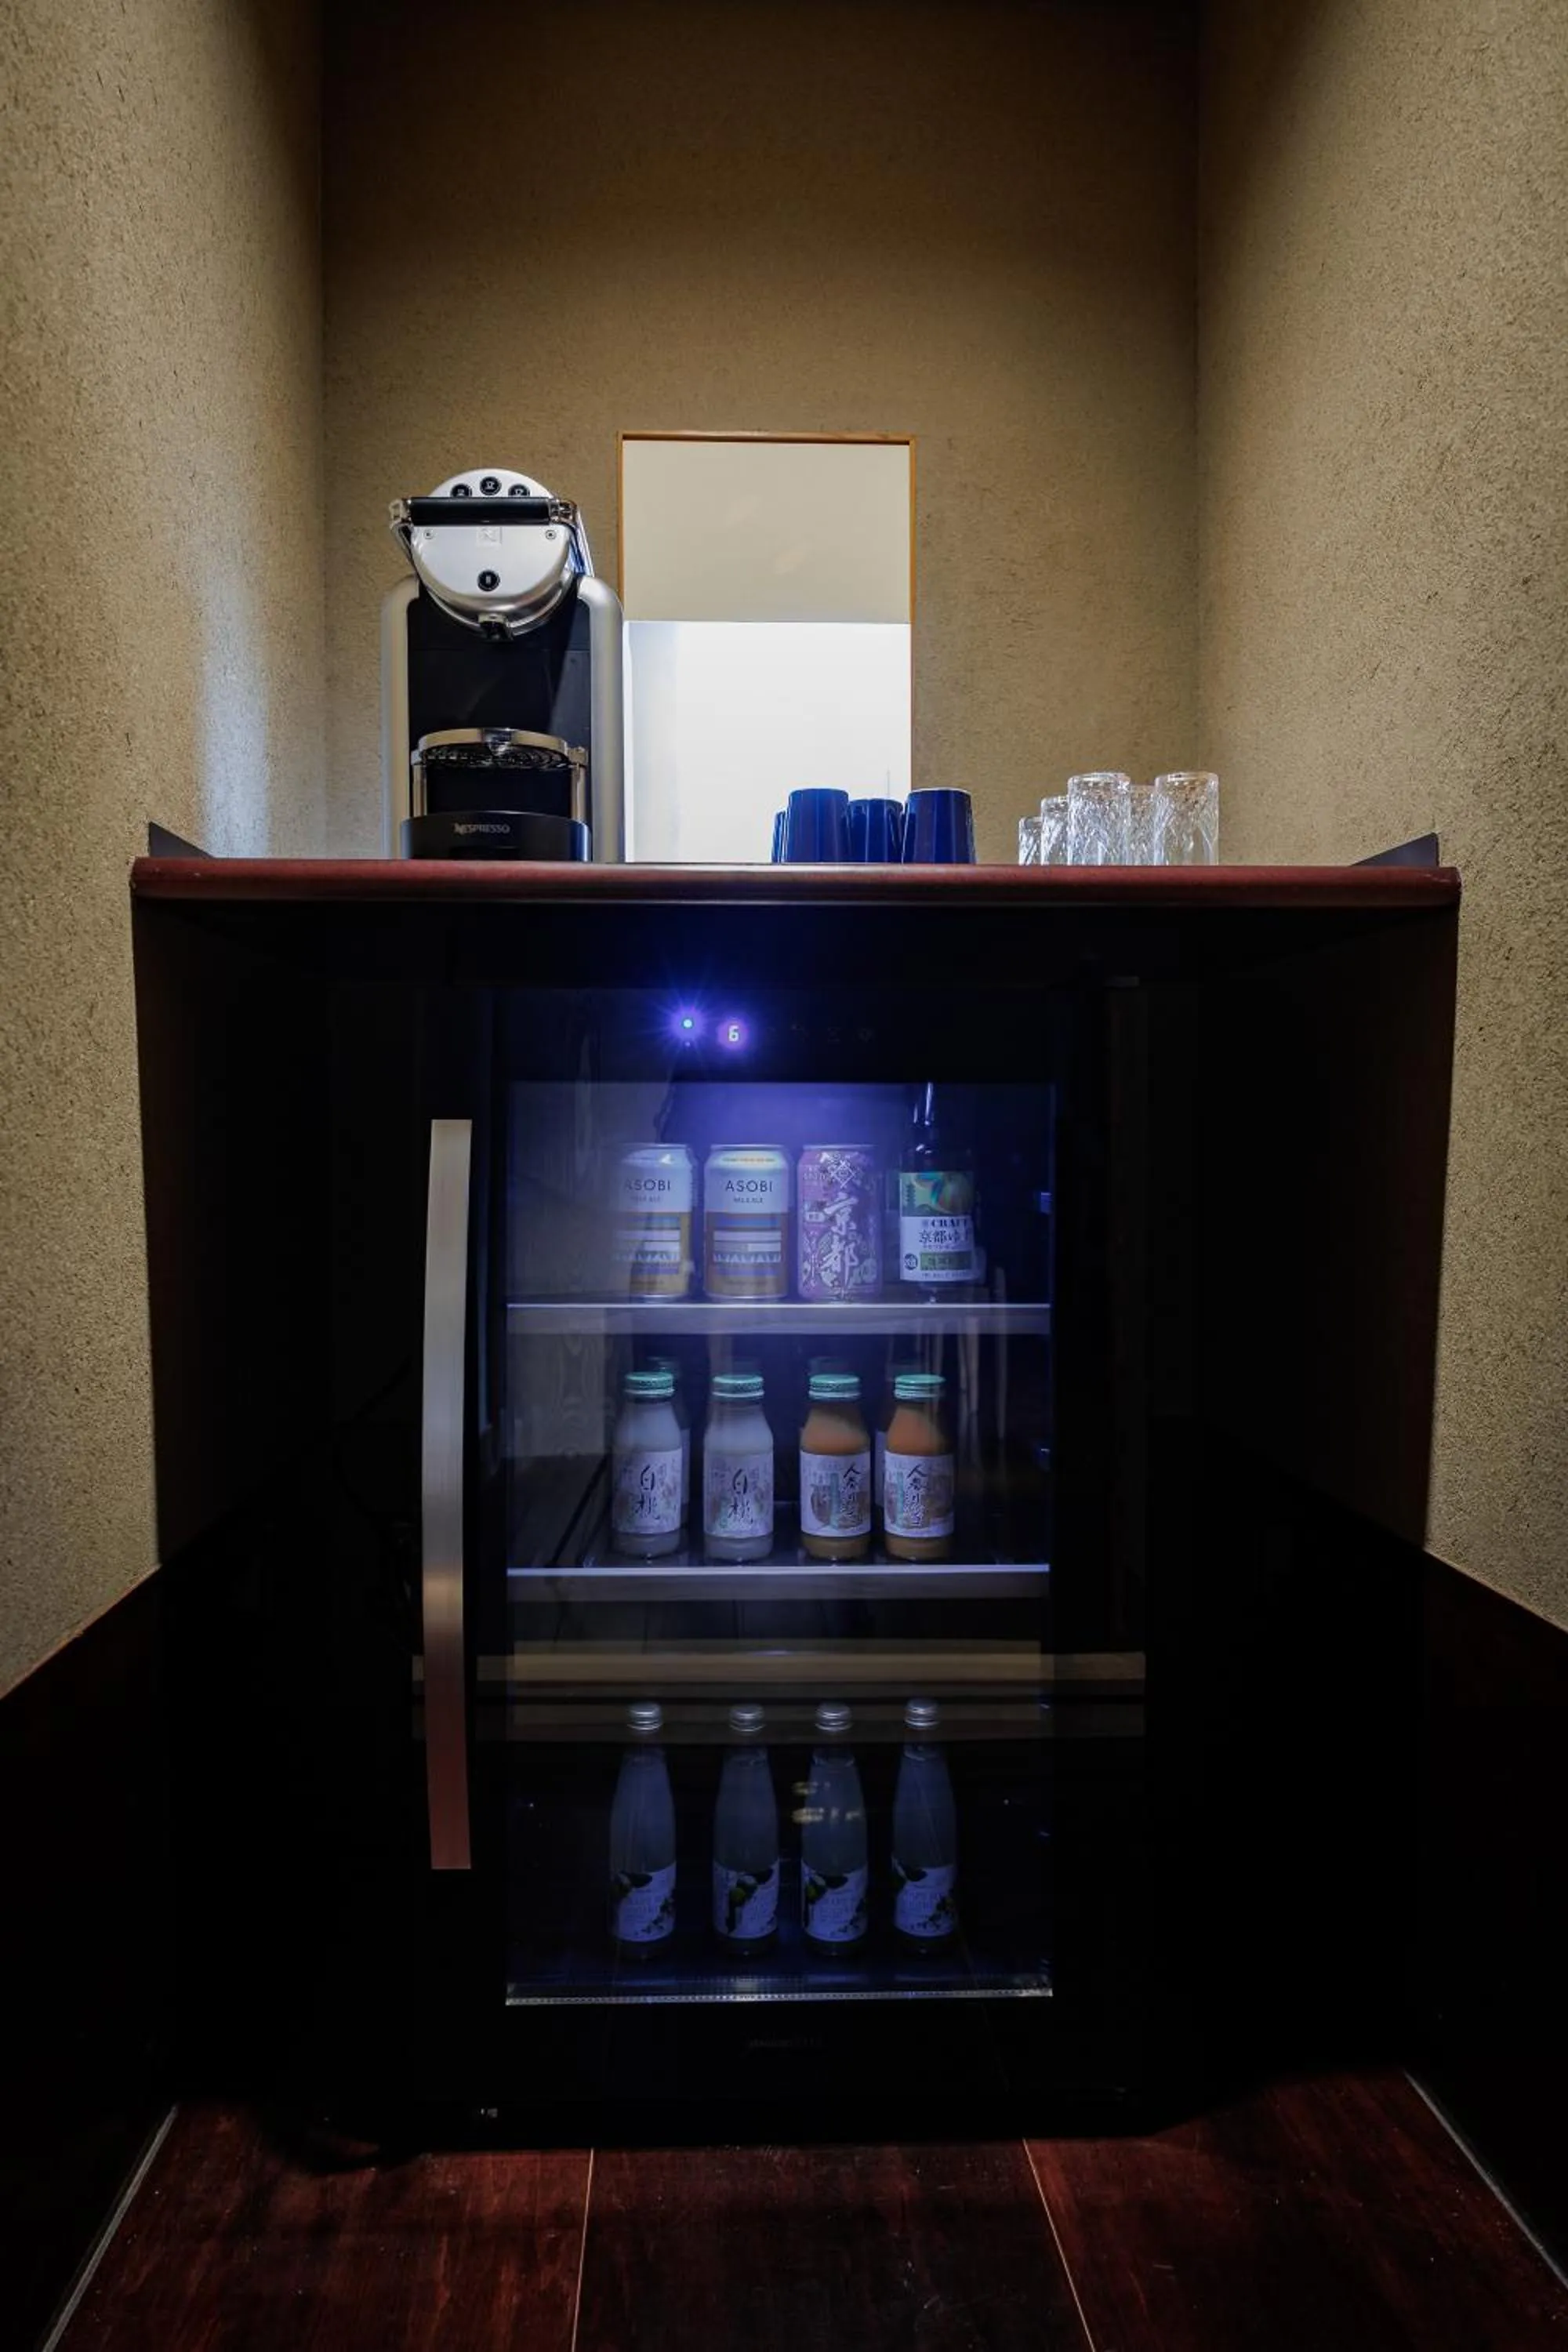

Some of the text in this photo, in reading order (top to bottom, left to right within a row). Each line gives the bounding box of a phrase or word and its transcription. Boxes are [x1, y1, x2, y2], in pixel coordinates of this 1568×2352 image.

[454, 822, 511, 835] NESPRESSO
[728, 1025, 740, 1042] 6
[624, 1178, 671, 1191] ASOBI
[725, 1179, 773, 1192] ASOBI
